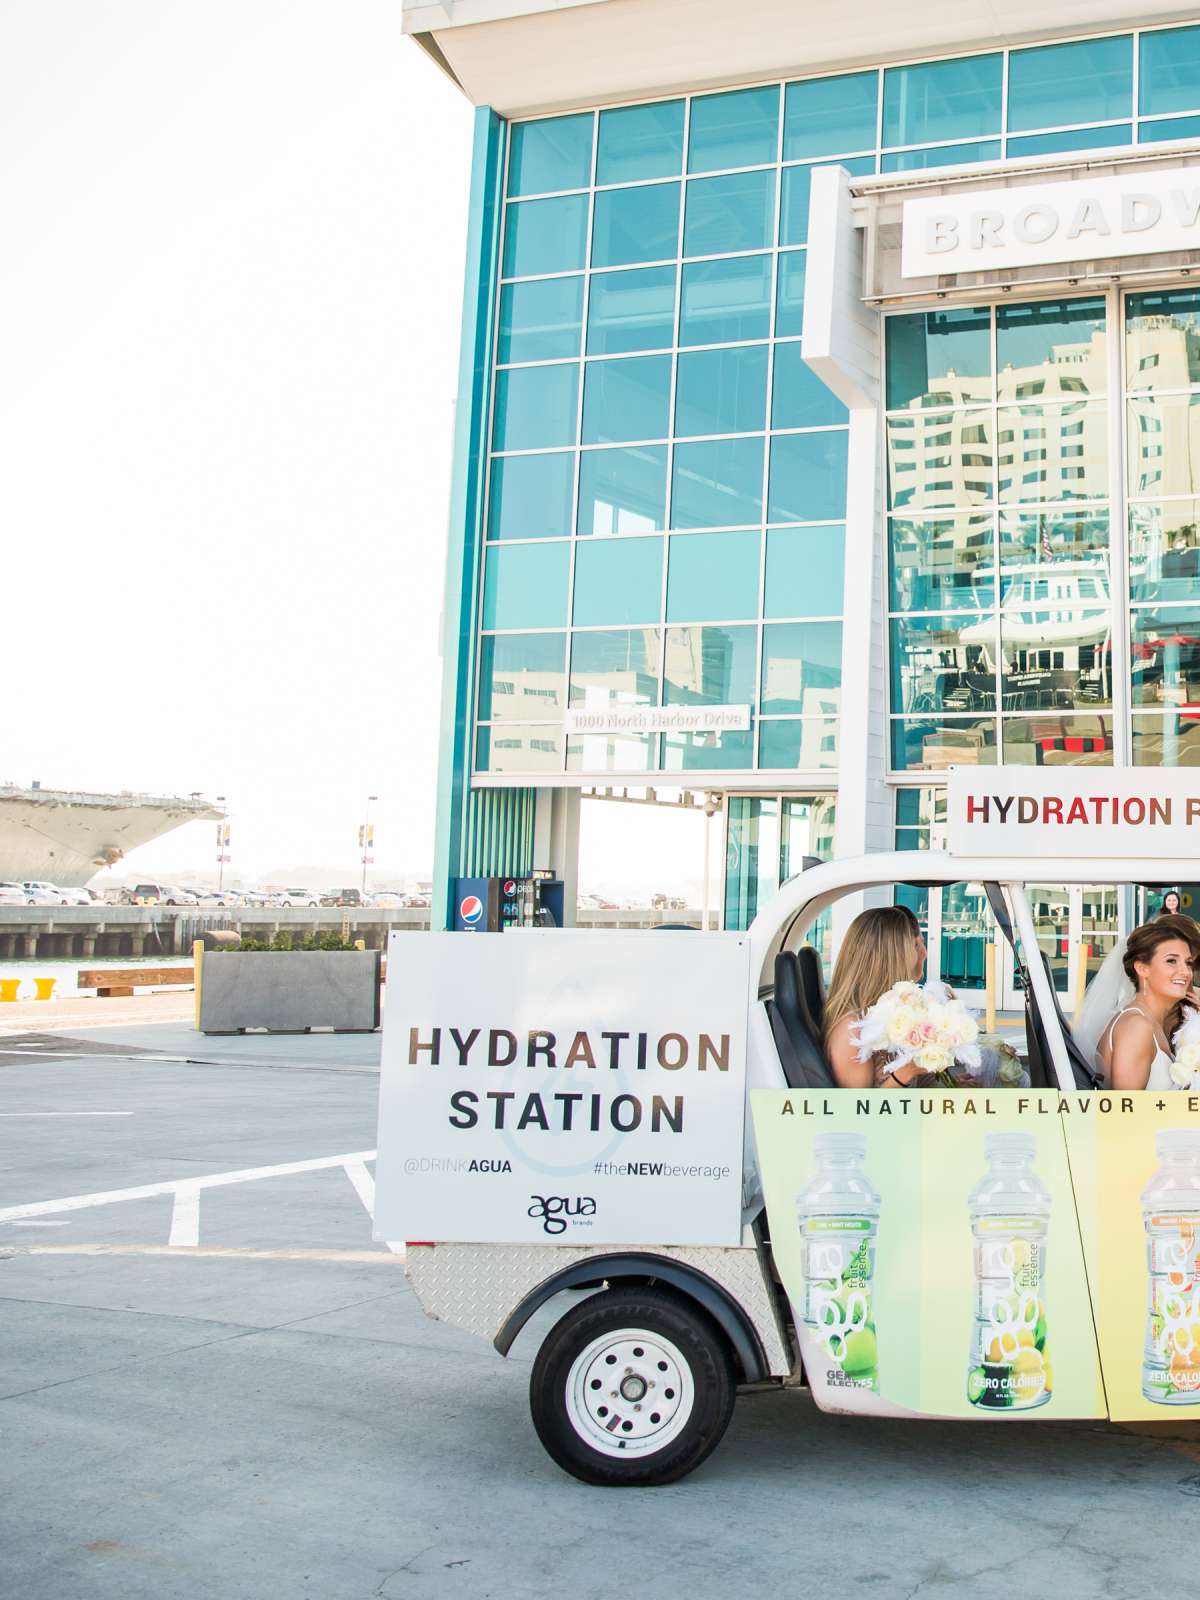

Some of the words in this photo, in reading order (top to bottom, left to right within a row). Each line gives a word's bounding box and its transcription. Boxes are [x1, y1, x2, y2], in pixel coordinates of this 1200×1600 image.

[574, 714, 604, 729] 1000
[608, 713, 647, 729] North
[651, 711, 700, 728] Harbor
[704, 710, 743, 727] Drive
[966, 795, 1172, 825] HYDRATION
[407, 1026, 732, 1072] HYDRATION
[448, 1090, 684, 1134] STATION
[781, 1099, 834, 1116] ALL
[856, 1098, 998, 1116] NATURAL
[1017, 1097, 1135, 1115] FLAVOR
[403, 1157, 512, 1176] @DRINKAGUA
[593, 1161, 731, 1180] #theNEWbeverage
[527, 1195, 597, 1234] agua
[1020, 1263, 1030, 1287] fruit
